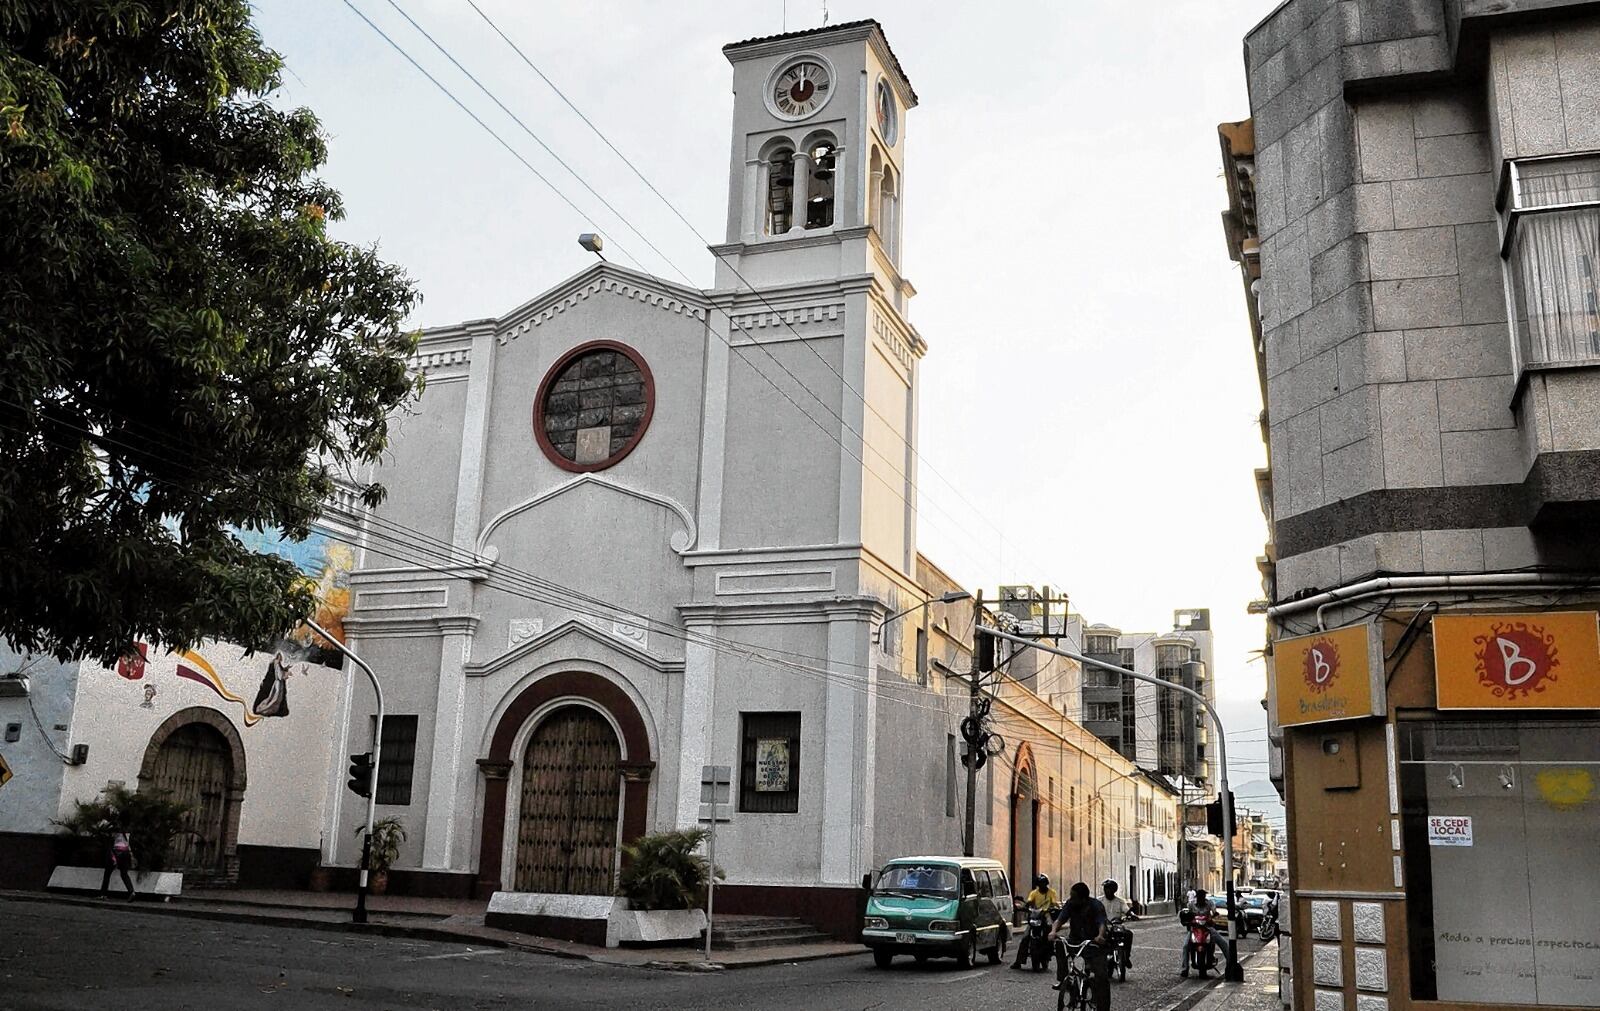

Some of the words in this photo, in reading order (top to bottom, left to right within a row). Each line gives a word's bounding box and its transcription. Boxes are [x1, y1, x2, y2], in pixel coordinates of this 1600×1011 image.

[1311, 648, 1330, 683] B
[1496, 637, 1536, 685] B
[1431, 818, 1442, 827] SE
[1444, 818, 1469, 827] CEDE
[1434, 827, 1467, 835] LOCAL
[1439, 932, 1471, 943] Moda
[1476, 936, 1485, 944] a
